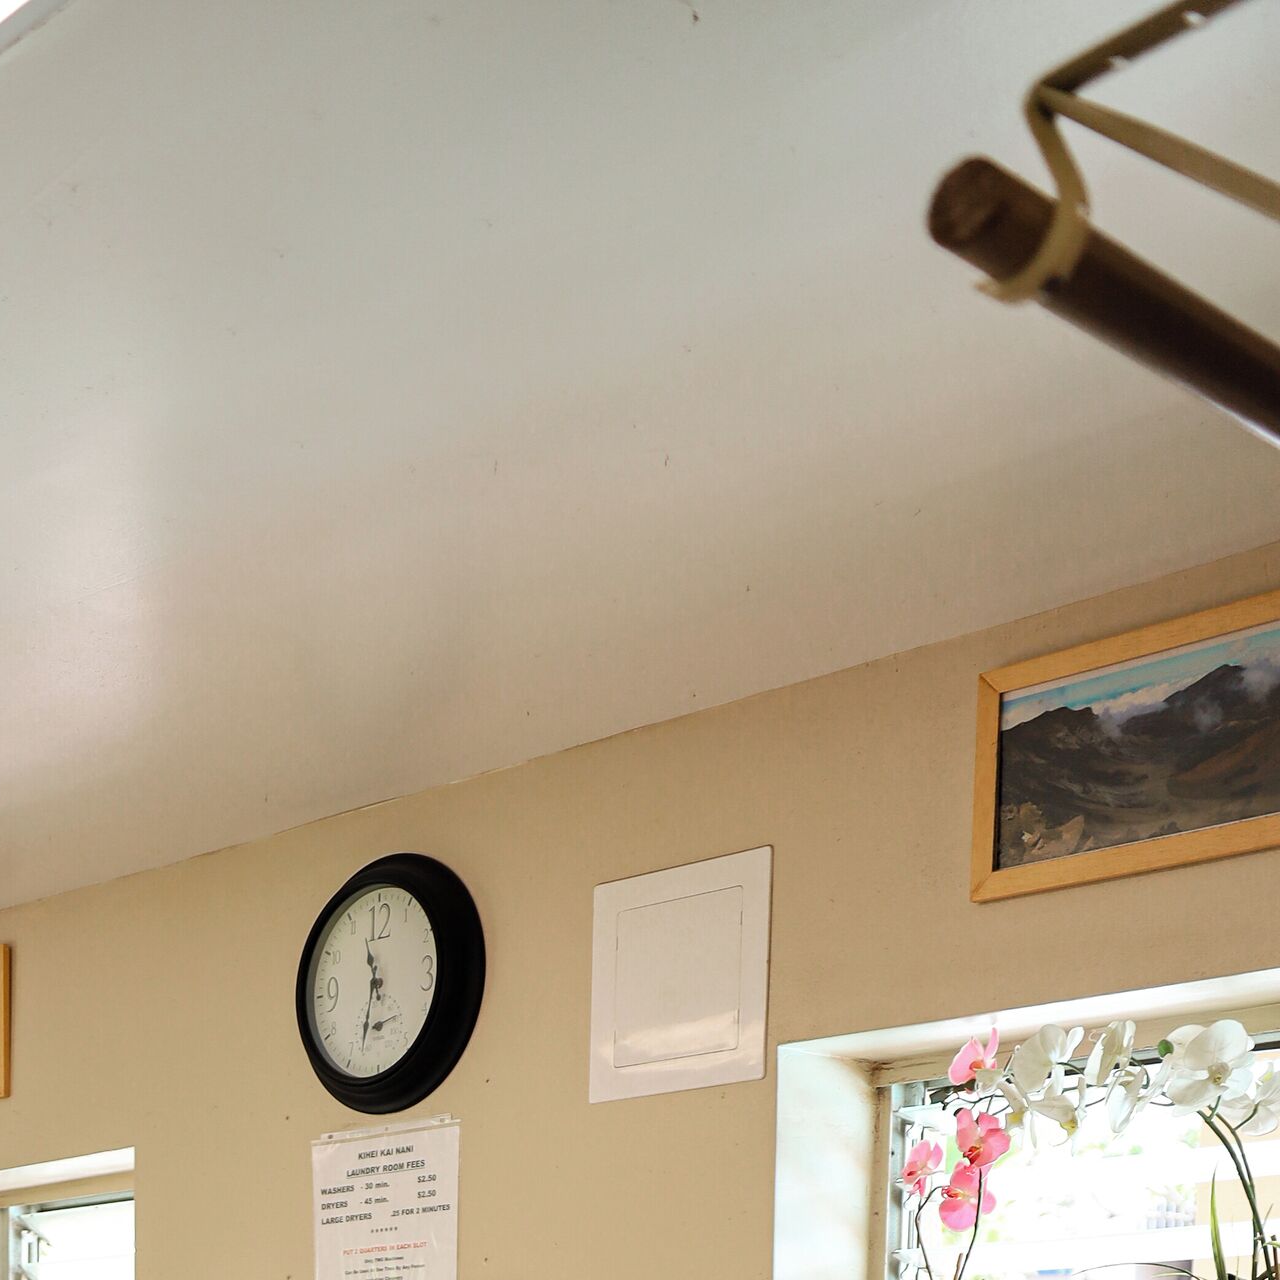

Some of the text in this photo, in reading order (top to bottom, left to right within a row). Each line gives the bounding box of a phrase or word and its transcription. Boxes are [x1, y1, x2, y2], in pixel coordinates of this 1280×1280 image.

[368, 903, 391, 942] 12
[422, 928, 429, 943] 2
[420, 955, 434, 992] 3
[327, 976, 339, 1013] 9
[358, 1145, 414, 1160] KIHEI KAI NANI
[346, 1159, 425, 1177] LAUNDRY ROOM FEES
[320, 1185, 355, 1195] WASHERS
[364, 1182, 373, 1190] 30
[417, 1174, 437, 1183] $2.50
[321, 1200, 348, 1210] DRYERS
[364, 1197, 373, 1205] 45
[417, 1189, 437, 1199] $2.50
[321, 1215, 344, 1225] LARGE
[345, 1212, 372, 1222] DRYERS
[401, 1207, 414, 1216] FOR
[421, 1203, 451, 1213] MINUTES
